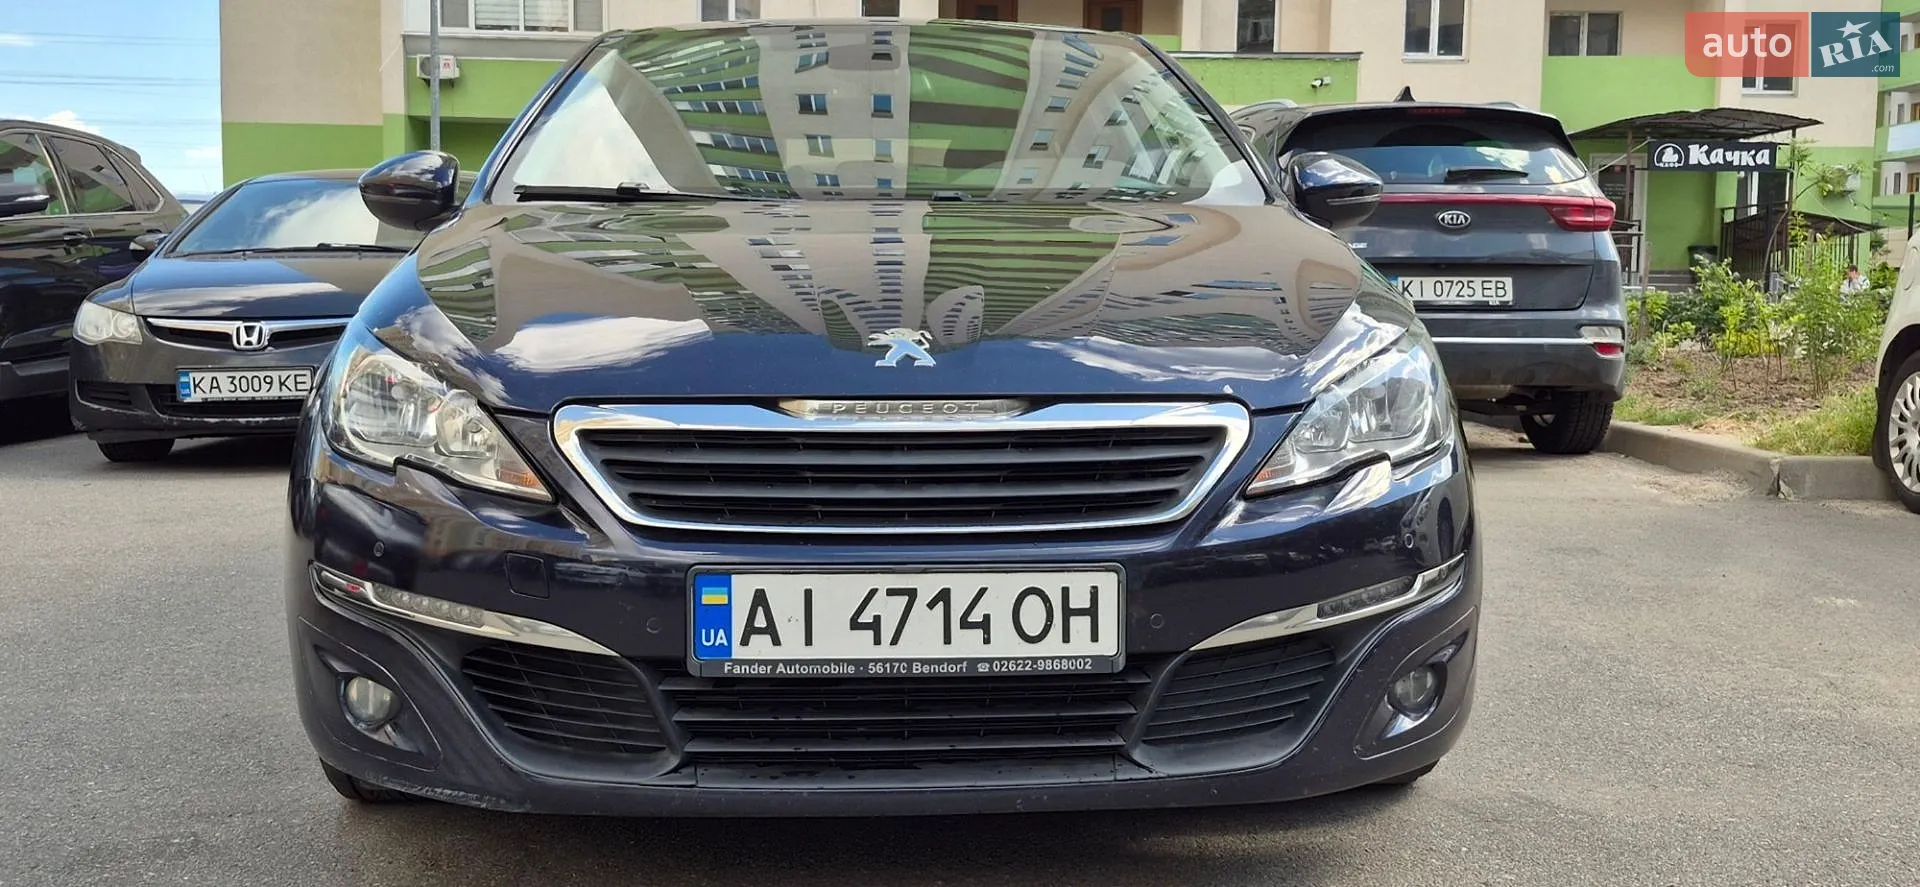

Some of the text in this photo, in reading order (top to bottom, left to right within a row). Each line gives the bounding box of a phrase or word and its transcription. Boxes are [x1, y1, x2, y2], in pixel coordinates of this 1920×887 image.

[1687, 143, 1770, 167] Качка
[1444, 214, 1466, 224] KIA
[1400, 280, 1507, 297] KI 0725 EB
[192, 373, 309, 394] KA 3009 KE
[832, 402, 980, 414] PEUGEOT
[739, 584, 1100, 647] AI 4714 OH
[701, 628, 729, 647] UA
[724, 662, 772, 674] Fander
[776, 662, 856, 674] Automobile
[912, 660, 968, 674] Bendorf
[992, 658, 1093, 672] 02622-9868002
